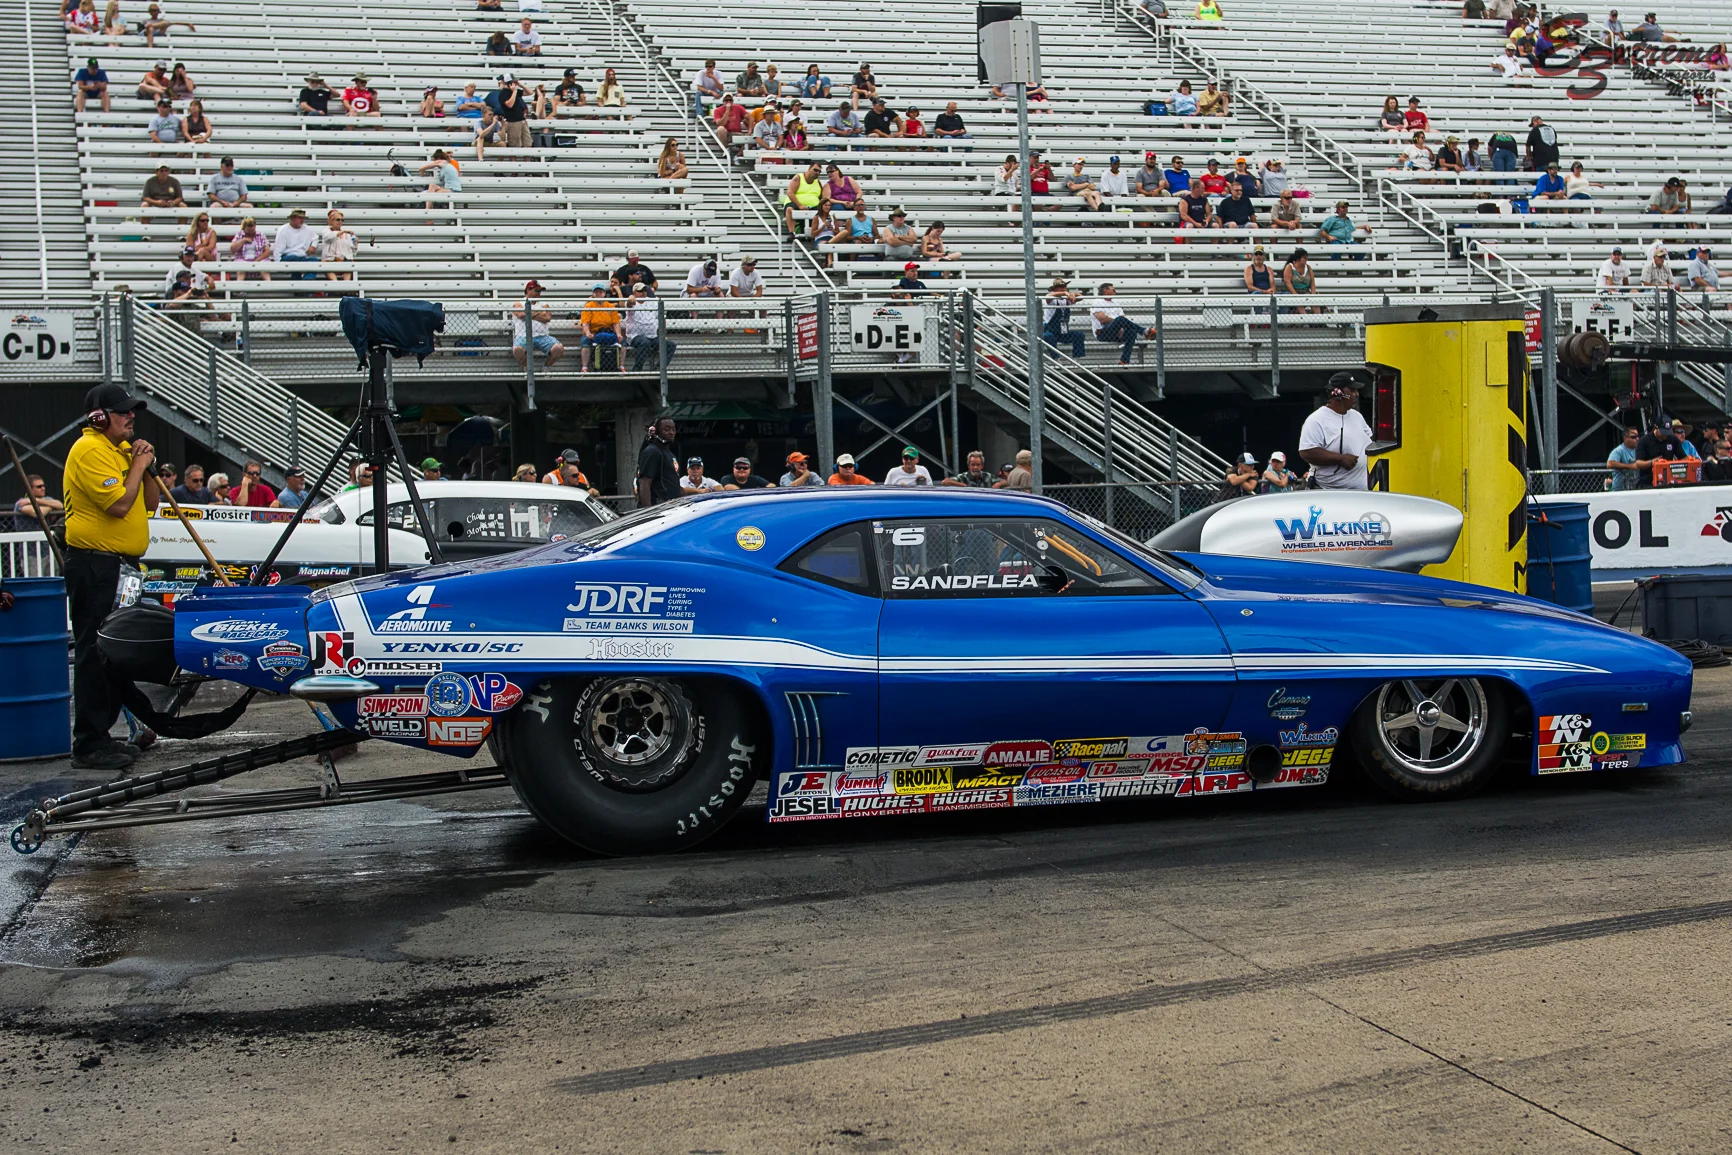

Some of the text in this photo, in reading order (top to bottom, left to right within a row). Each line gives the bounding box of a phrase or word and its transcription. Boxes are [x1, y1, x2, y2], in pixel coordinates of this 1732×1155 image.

[867, 325, 909, 349] D-E
[3, 333, 56, 360] C-D
[163, 510, 200, 518] Mildon
[204, 509, 250, 520] Hoosier
[1273, 505, 1383, 541] WILKINS
[1593, 510, 1668, 549] OL
[893, 527, 925, 546] 6
[1282, 541, 1325, 549] WHEELS
[299, 567, 349, 577] MagnaFuel
[892, 574, 1038, 590] SANDFLEA
[566, 584, 668, 612] JDRF
[212, 623, 278, 632] BICKEL
[377, 621, 452, 632] AEROMOTIVE
[615, 622, 647, 630] BANKS
[220, 631, 252, 639] RACE
[383, 643, 523, 654] YENKO/SC
[585, 637, 675, 660] Hoosier
[368, 662, 441, 670] MOSER
[469, 673, 507, 711] VP
[494, 692, 523, 706] Racing
[1267, 687, 1311, 708] Camaro
[363, 698, 424, 712] SIMPSON
[432, 703, 467, 715] VALVE SPRINGS
[573, 677, 603, 725] RACIN
[372, 721, 422, 732] WELD
[430, 721, 484, 741] NOS
[695, 715, 706, 753] USA
[847, 750, 917, 765] COMETIC
[986, 750, 1050, 764] AMALIE
[1070, 741, 1127, 758] Racepak
[1282, 748, 1335, 765] JEGS
[574, 738, 604, 782] WELD
[1148, 756, 1205, 772] MSD
[1209, 755, 1244, 767] JEGS
[1591, 753, 1625, 763] racer
[896, 768, 949, 787] BRODIX
[1030, 767, 1081, 778] LUCAS OIL
[1274, 768, 1319, 783] OMP
[677, 734, 756, 835] Hoosier
[836, 773, 886, 795] SUMMIT
[956, 774, 1023, 789] IMPACT
[1101, 779, 1178, 797] MOROSO
[1178, 773, 1250, 794] ARP
[932, 789, 1011, 805] HUGHES
[1028, 783, 1098, 798] MEZIERE
[770, 797, 838, 816] JESEL
[843, 795, 926, 811] HUGHES
[932, 802, 1011, 812] TRANSMISSIONS
[845, 808, 926, 817] CONVERTERS
